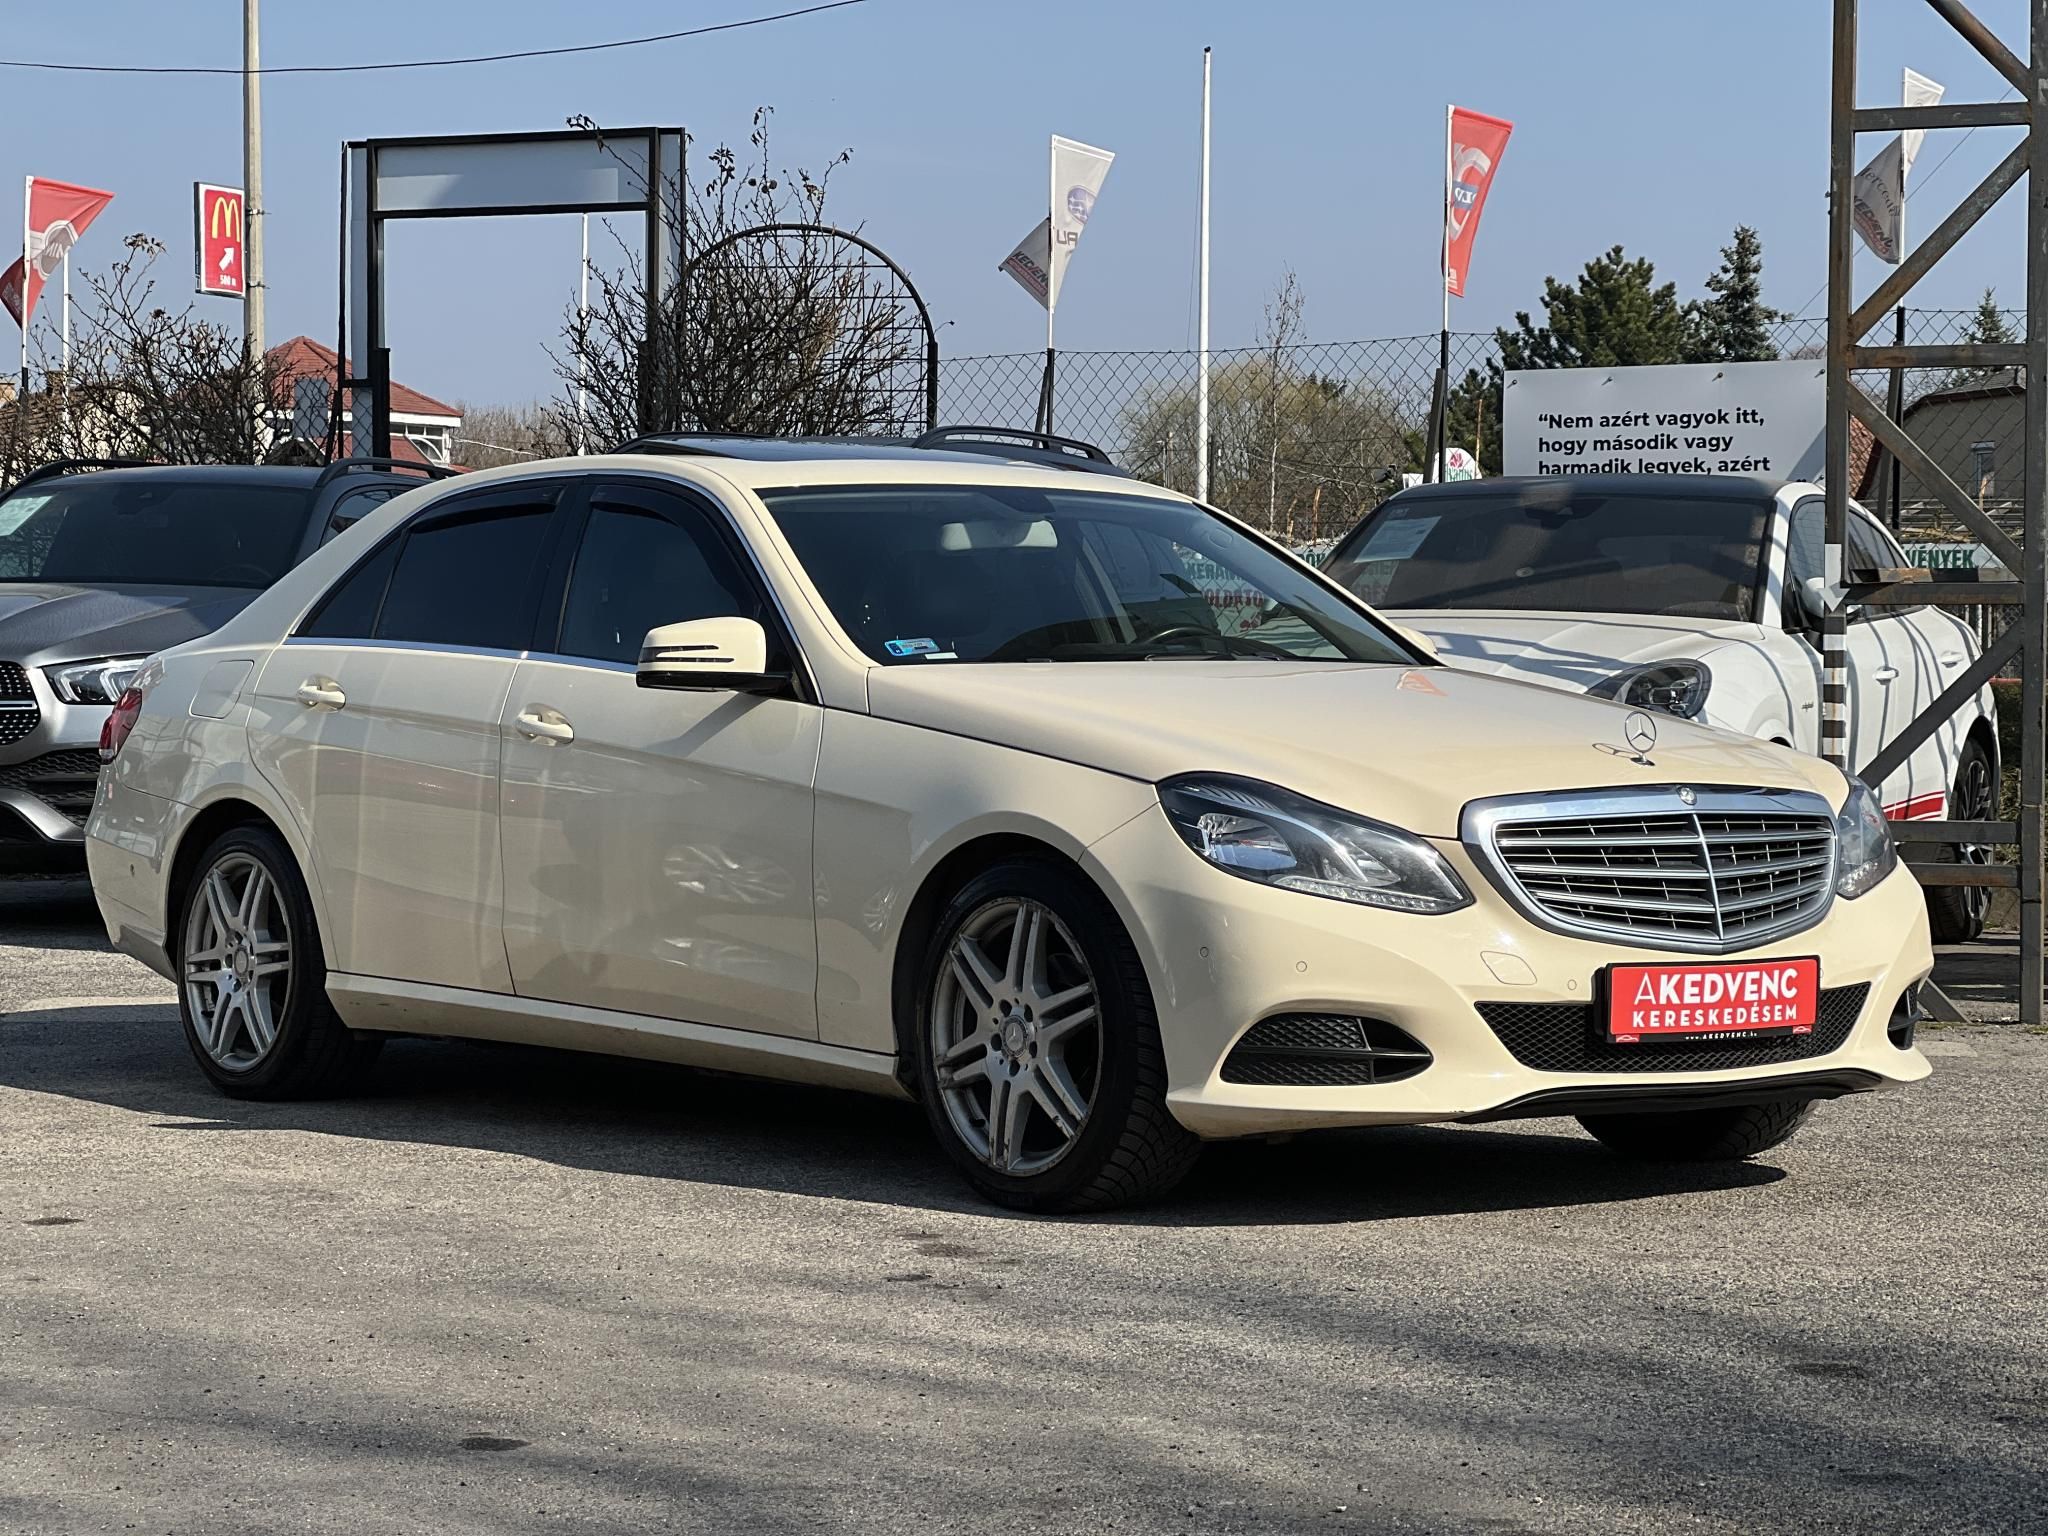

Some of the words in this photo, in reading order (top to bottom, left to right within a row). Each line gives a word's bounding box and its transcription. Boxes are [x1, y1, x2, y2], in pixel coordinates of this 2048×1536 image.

[1599, 410, 1650, 428] azért
[1655, 408, 1730, 429] vagyok
[1735, 406, 1765, 427] itt,
[1538, 437, 1588, 456] hogy
[1593, 434, 1679, 452] második
[1684, 435, 1734, 452] vagy
[1538, 457, 1632, 475] harmadik
[1717, 455, 1771, 473] azért
[1903, 545, 1975, 569] VÉNYEK
[1632, 1002, 1798, 1028] KERESKEDÉSEM
